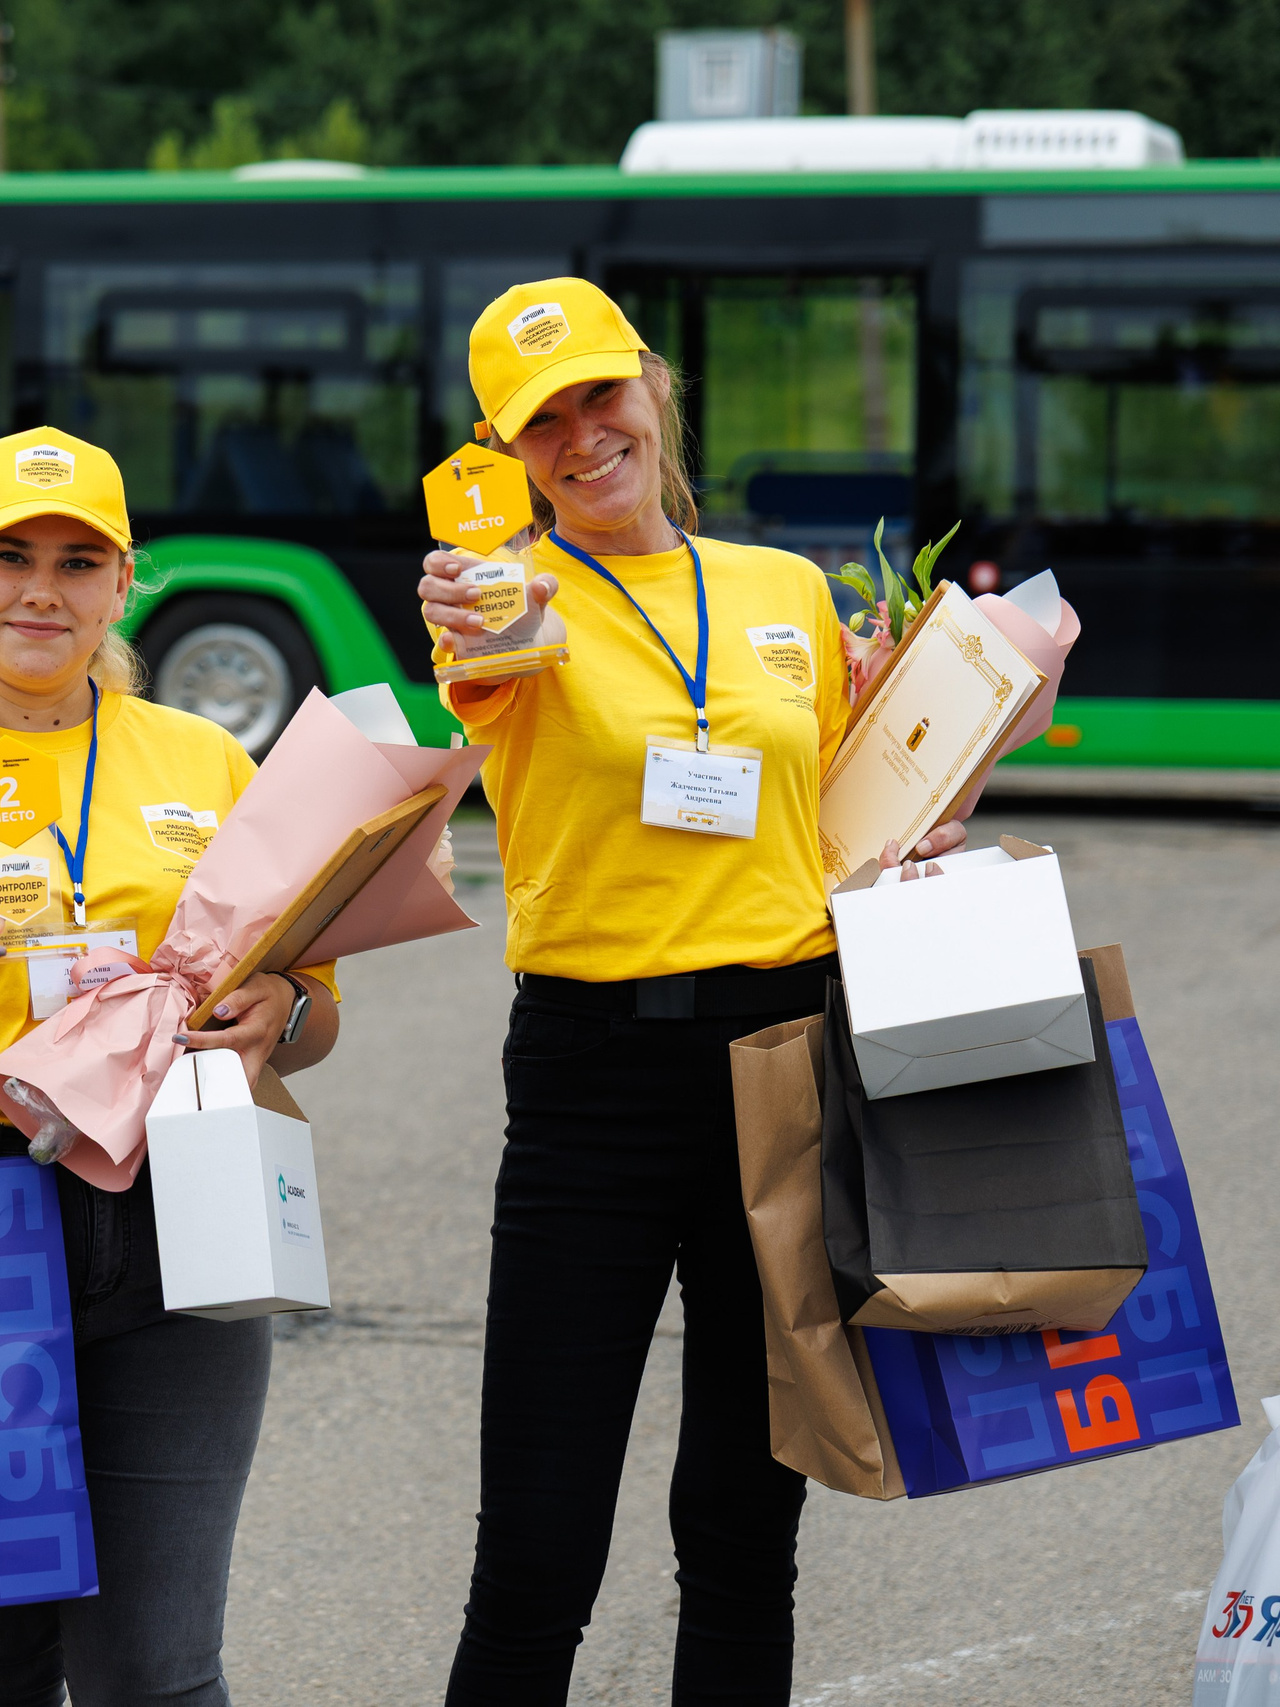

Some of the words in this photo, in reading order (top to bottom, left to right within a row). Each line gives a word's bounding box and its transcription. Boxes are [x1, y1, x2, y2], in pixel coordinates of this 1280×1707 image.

[521, 307, 546, 324] ЛУЧШИЙ
[525, 320, 552, 335] РАБОТНИК
[519, 322, 564, 346] ПАССАЖИРСКОГО
[527, 329, 560, 347] ТРАНСПОРТА
[20, 466, 70, 474] ПАССАЖИРСКОГО
[465, 484, 484, 515] 1
[458, 515, 505, 533] МЕСТО
[475, 567, 505, 581] ЛУЧШИЙ
[474, 600, 516, 613] РЕВИЗОР
[765, 629, 796, 640] ЛУЧШИЙ
[771, 648, 802, 656] РАБОТНИК
[687, 770, 723, 782] Участник
[708, 786, 738, 797] Татьяна
[684, 794, 722, 805] Андреевна
[2, 861, 30, 873] ЛУЧШИЙ
[1240, 1595, 1255, 1605] ЛЕТ
